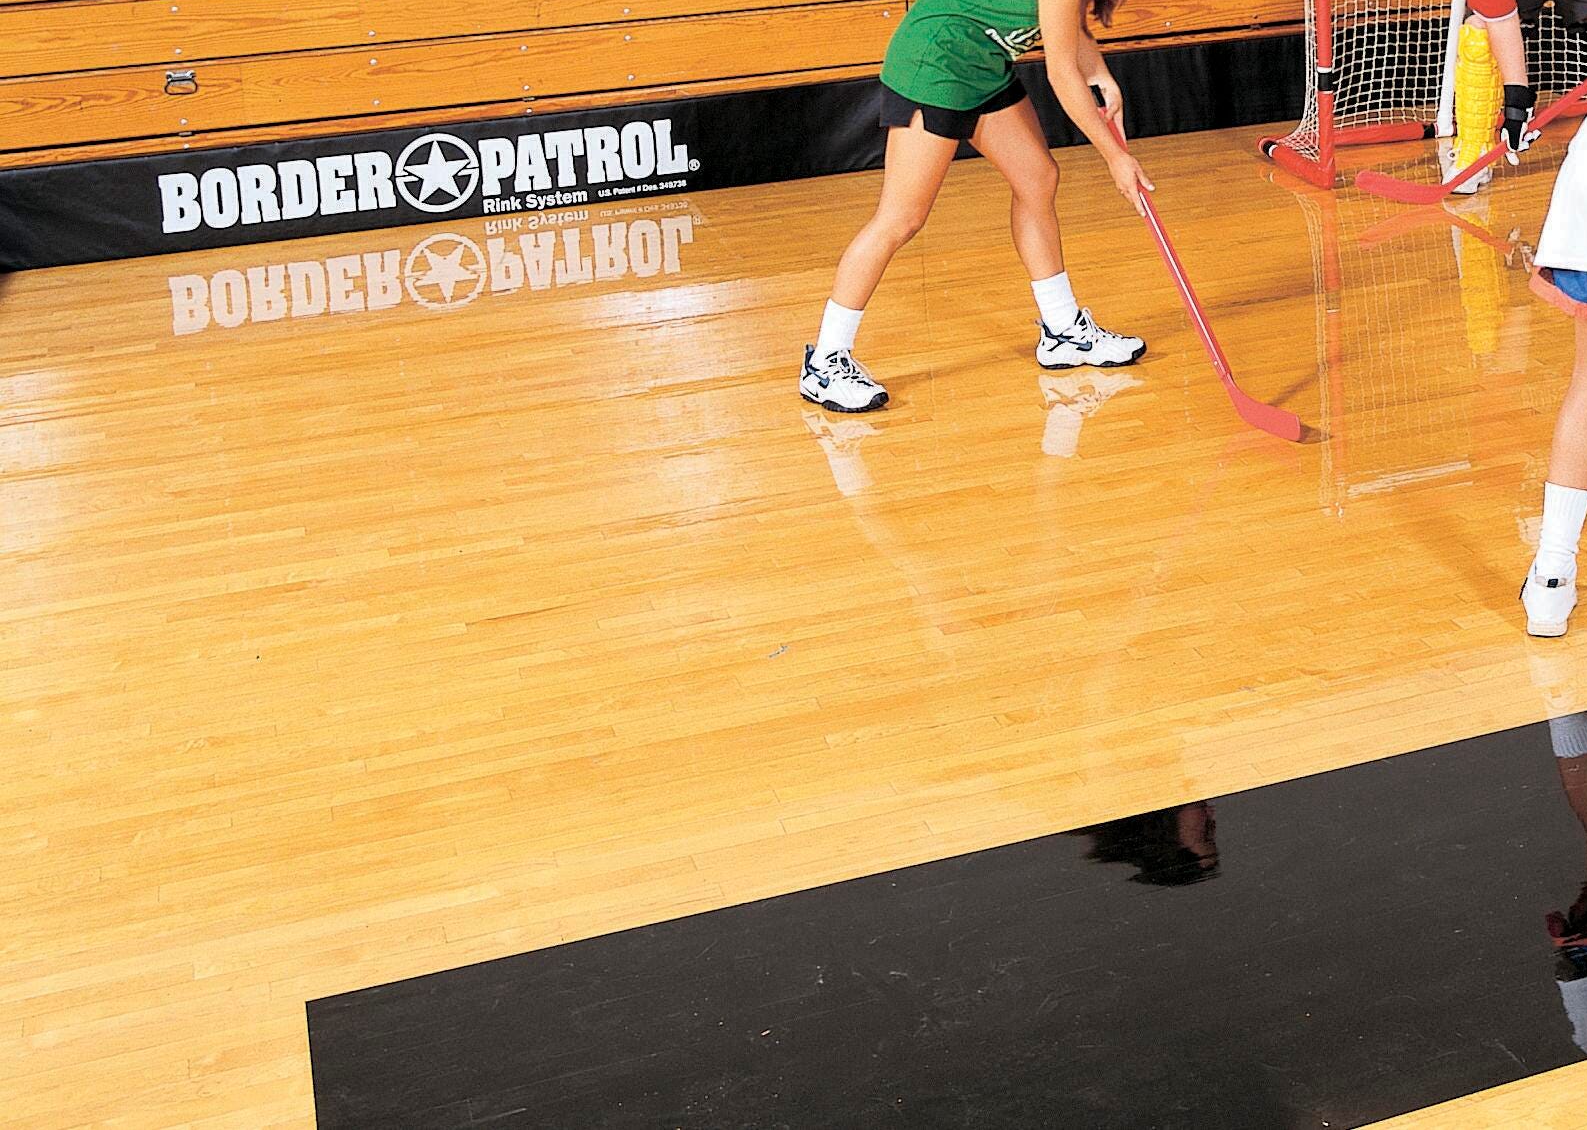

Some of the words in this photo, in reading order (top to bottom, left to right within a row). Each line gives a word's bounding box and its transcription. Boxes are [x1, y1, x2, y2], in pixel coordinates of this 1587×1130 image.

[158, 151, 397, 234] BORDER
[483, 196, 523, 214] Rink
[525, 189, 588, 210] System
